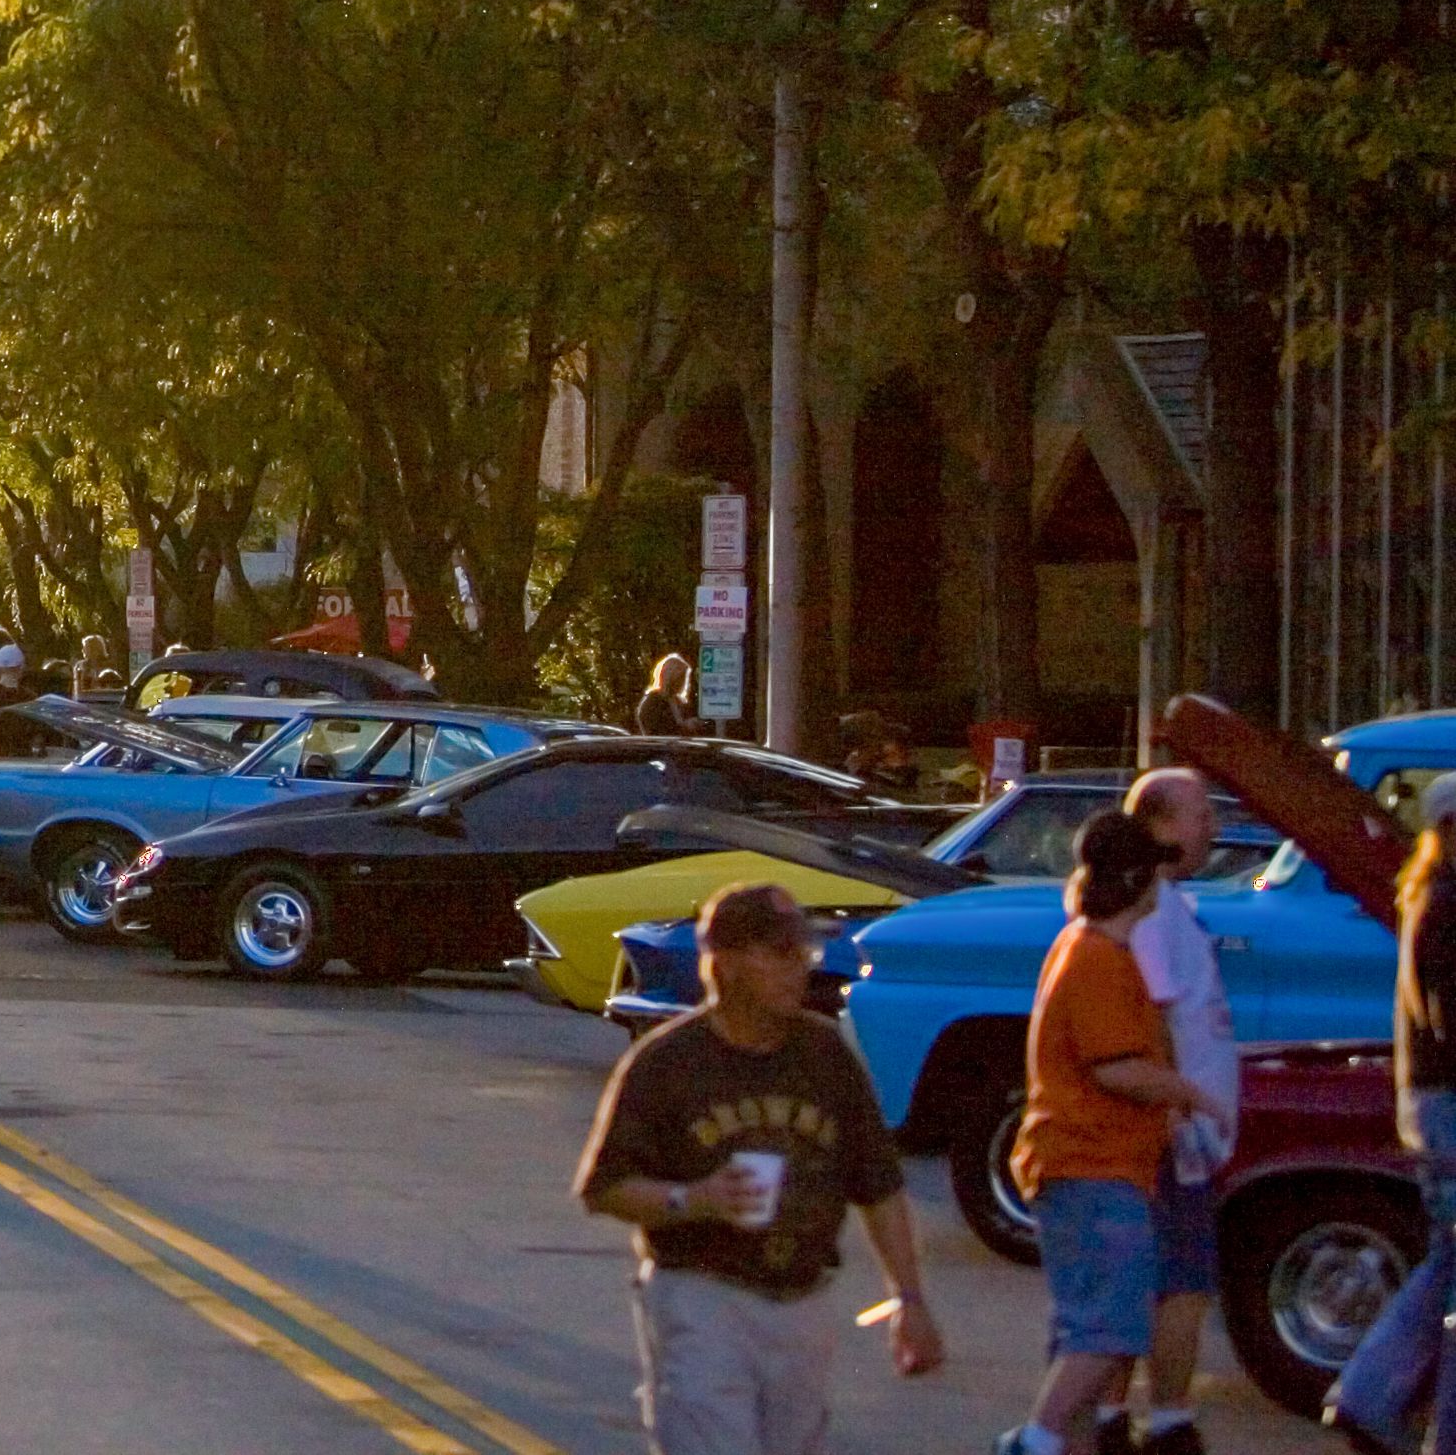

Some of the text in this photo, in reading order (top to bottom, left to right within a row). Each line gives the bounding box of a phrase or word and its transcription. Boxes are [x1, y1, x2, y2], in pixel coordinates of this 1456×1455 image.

[713, 590, 728, 602] NO
[697, 606, 744, 619] PARKING
[703, 651, 713, 669] 2
